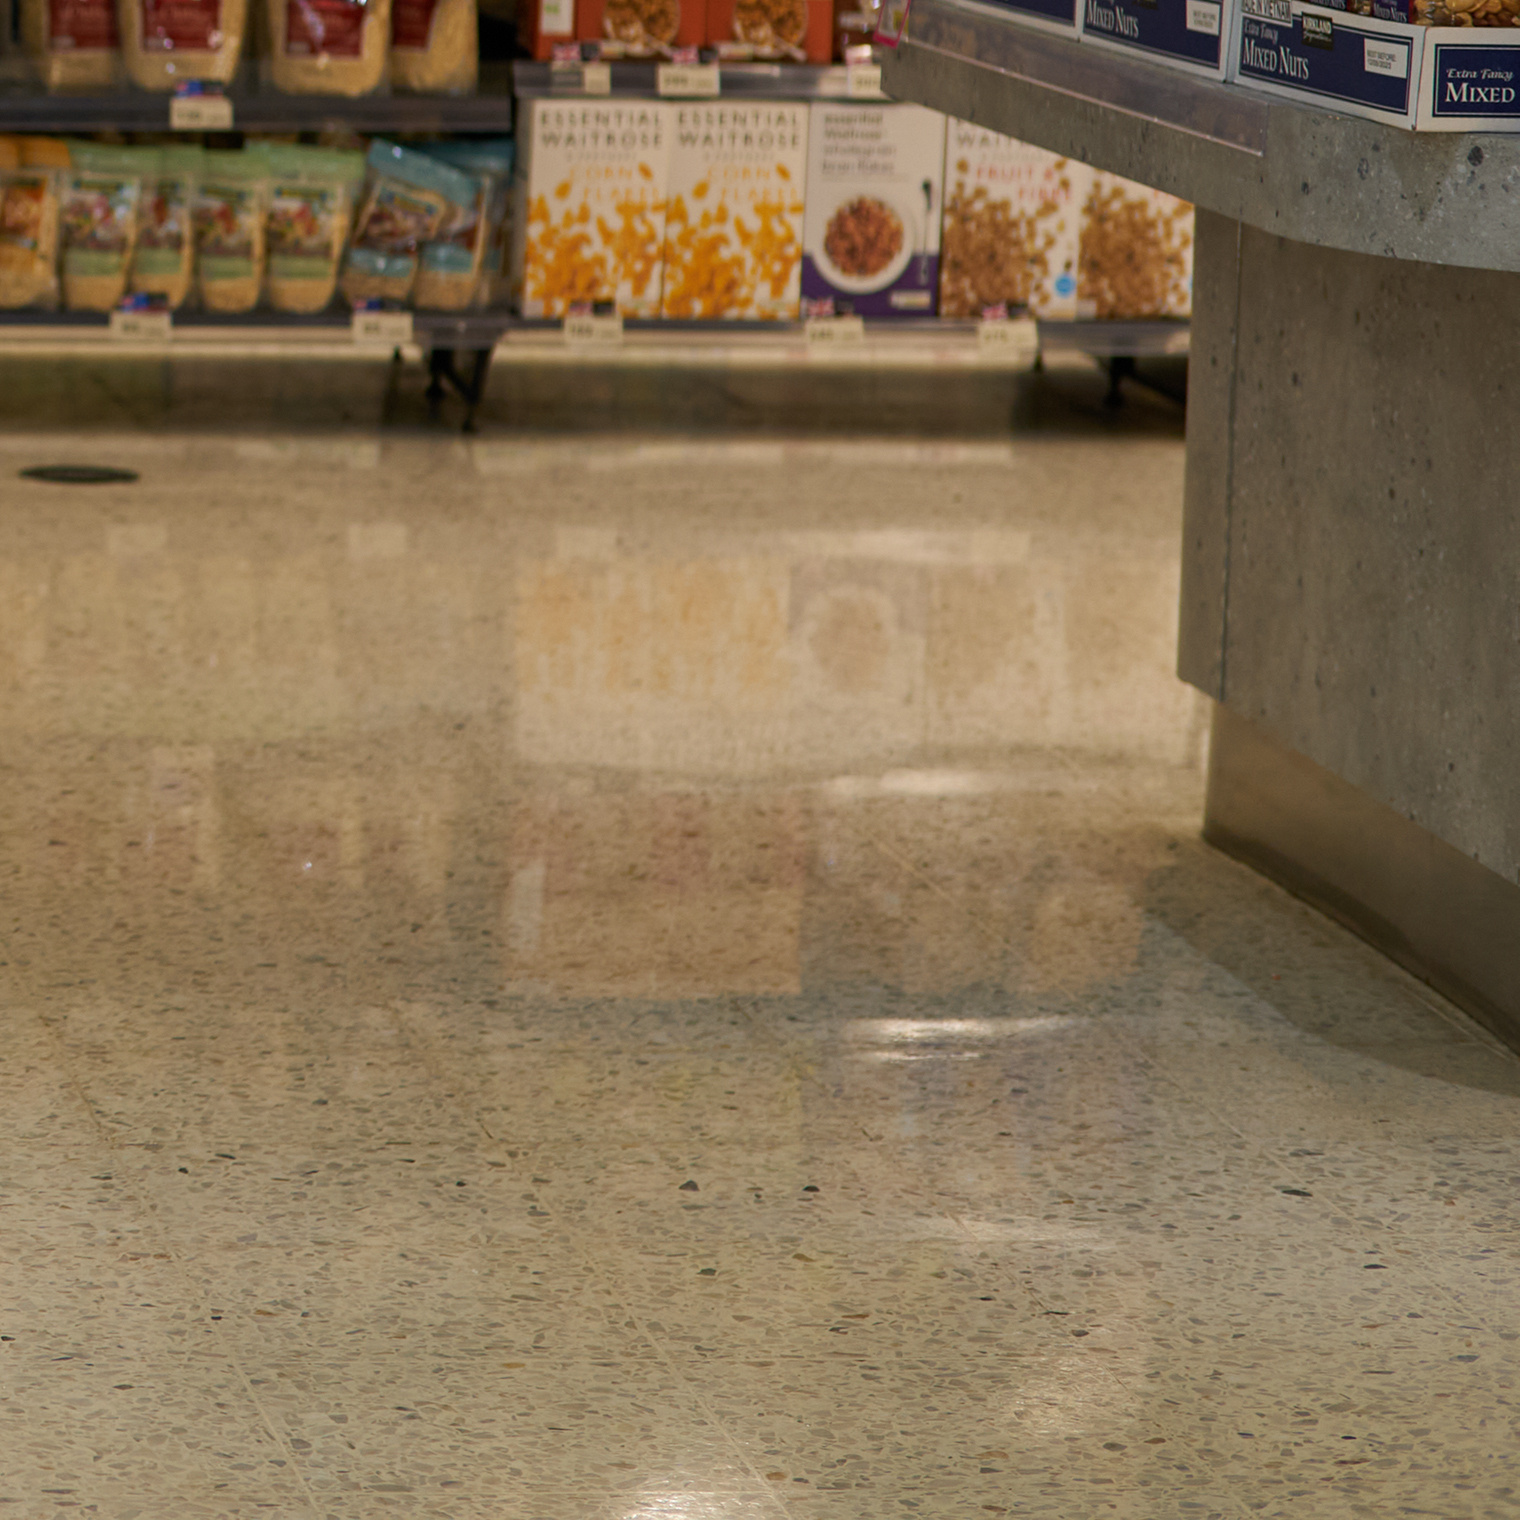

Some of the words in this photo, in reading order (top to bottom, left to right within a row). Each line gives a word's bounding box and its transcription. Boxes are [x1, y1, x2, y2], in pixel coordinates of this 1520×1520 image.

[1243, 39, 1277, 74] MIXED
[1278, 46, 1310, 80] NUTS
[1446, 67, 1477, 80] Extra
[1480, 67, 1515, 81] Fancy
[1446, 82, 1515, 103] MIXED
